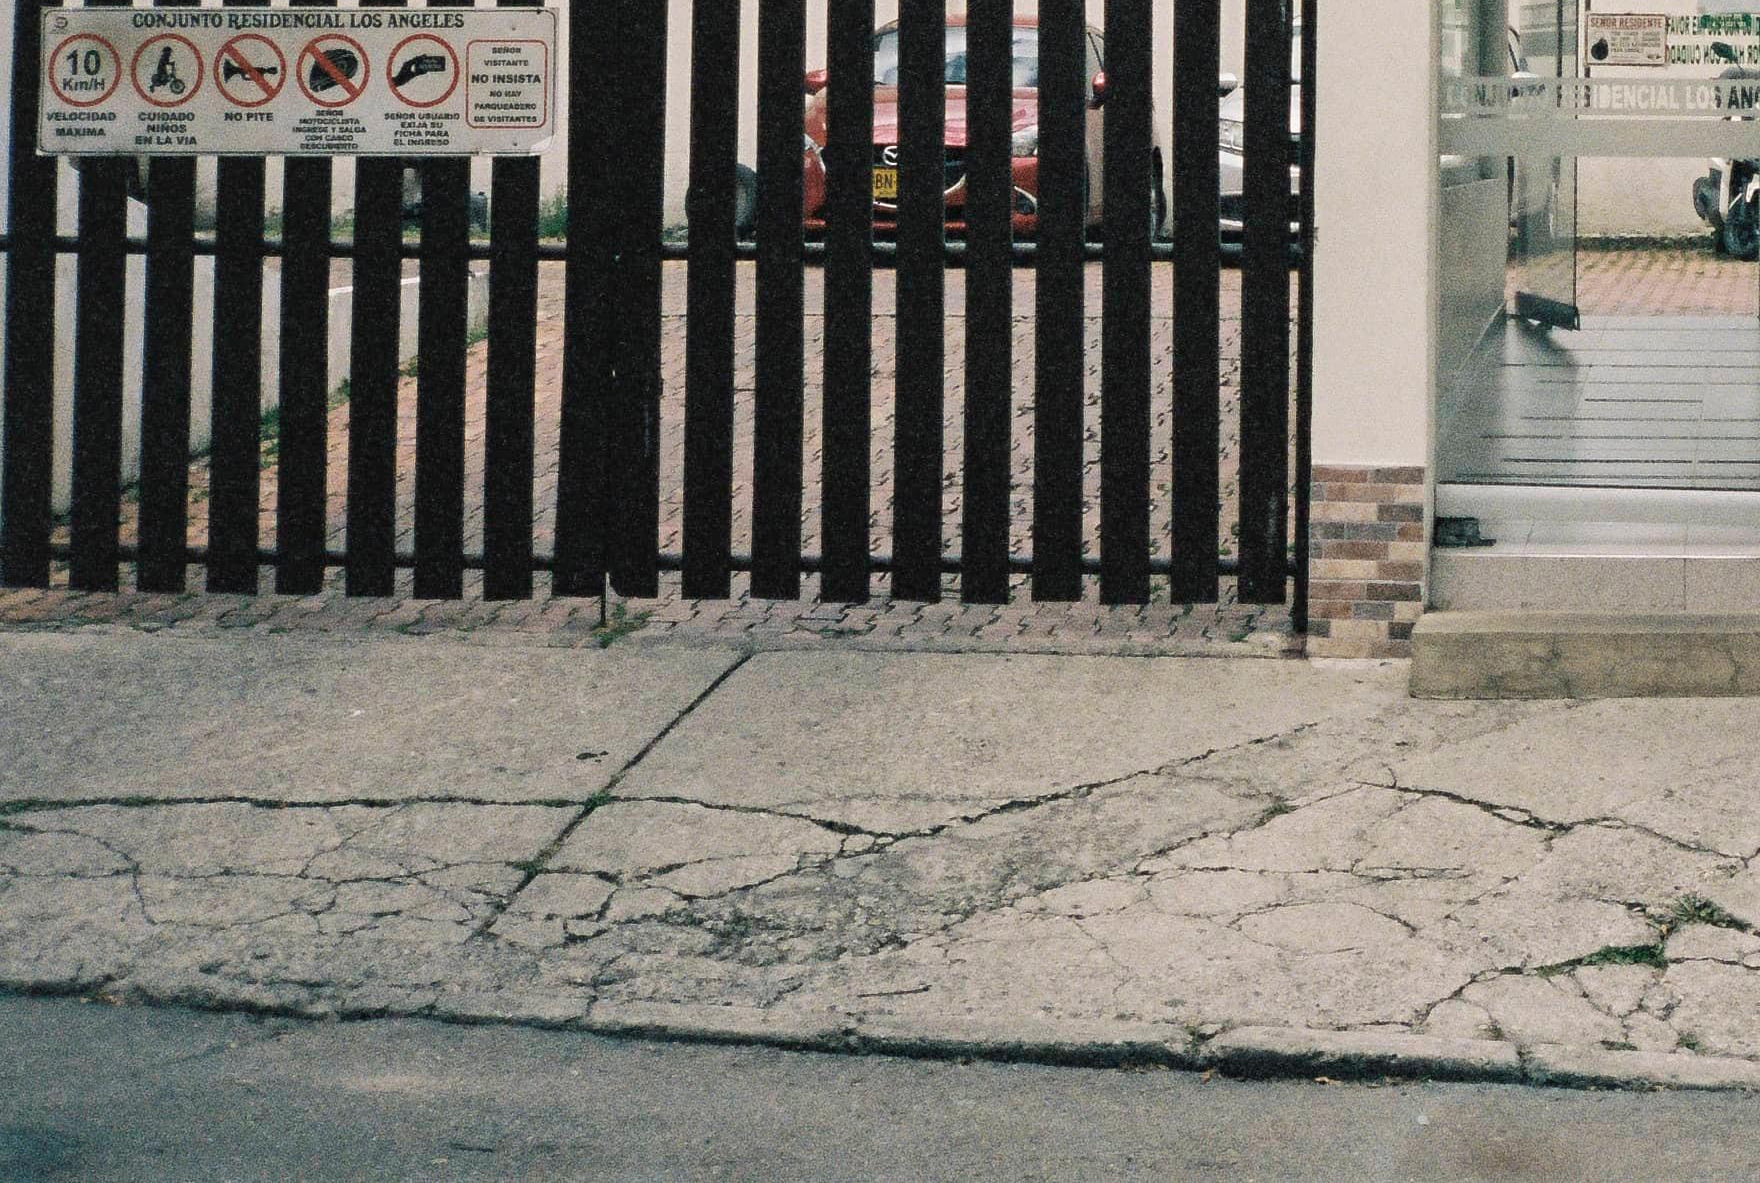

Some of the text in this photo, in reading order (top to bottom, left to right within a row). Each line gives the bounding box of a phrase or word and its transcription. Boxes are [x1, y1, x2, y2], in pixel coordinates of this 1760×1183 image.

[132, 13, 465, 30] CONJUNTO RESIDENCIAL LOS ANGELES
[1620, 17, 1662, 28] RESIDENTE
[66, 48, 101, 76] 10
[471, 74, 541, 84] NO INSISTA
[62, 78, 105, 91] Km/H
[489, 90, 522, 98] NO HAY
[1686, 85, 1722, 109] LOS
[474, 102, 537, 110] PARQUEADERO
[47, 111, 117, 121] VELOCIDAD
[138, 111, 196, 121] CUIDADO
[223, 111, 274, 122] NO PITE
[474, 115, 538, 123] DE VISITANTES
[135, 135, 197, 145] EN LA VIA
[393, 138, 450, 146] EL INGRESO
